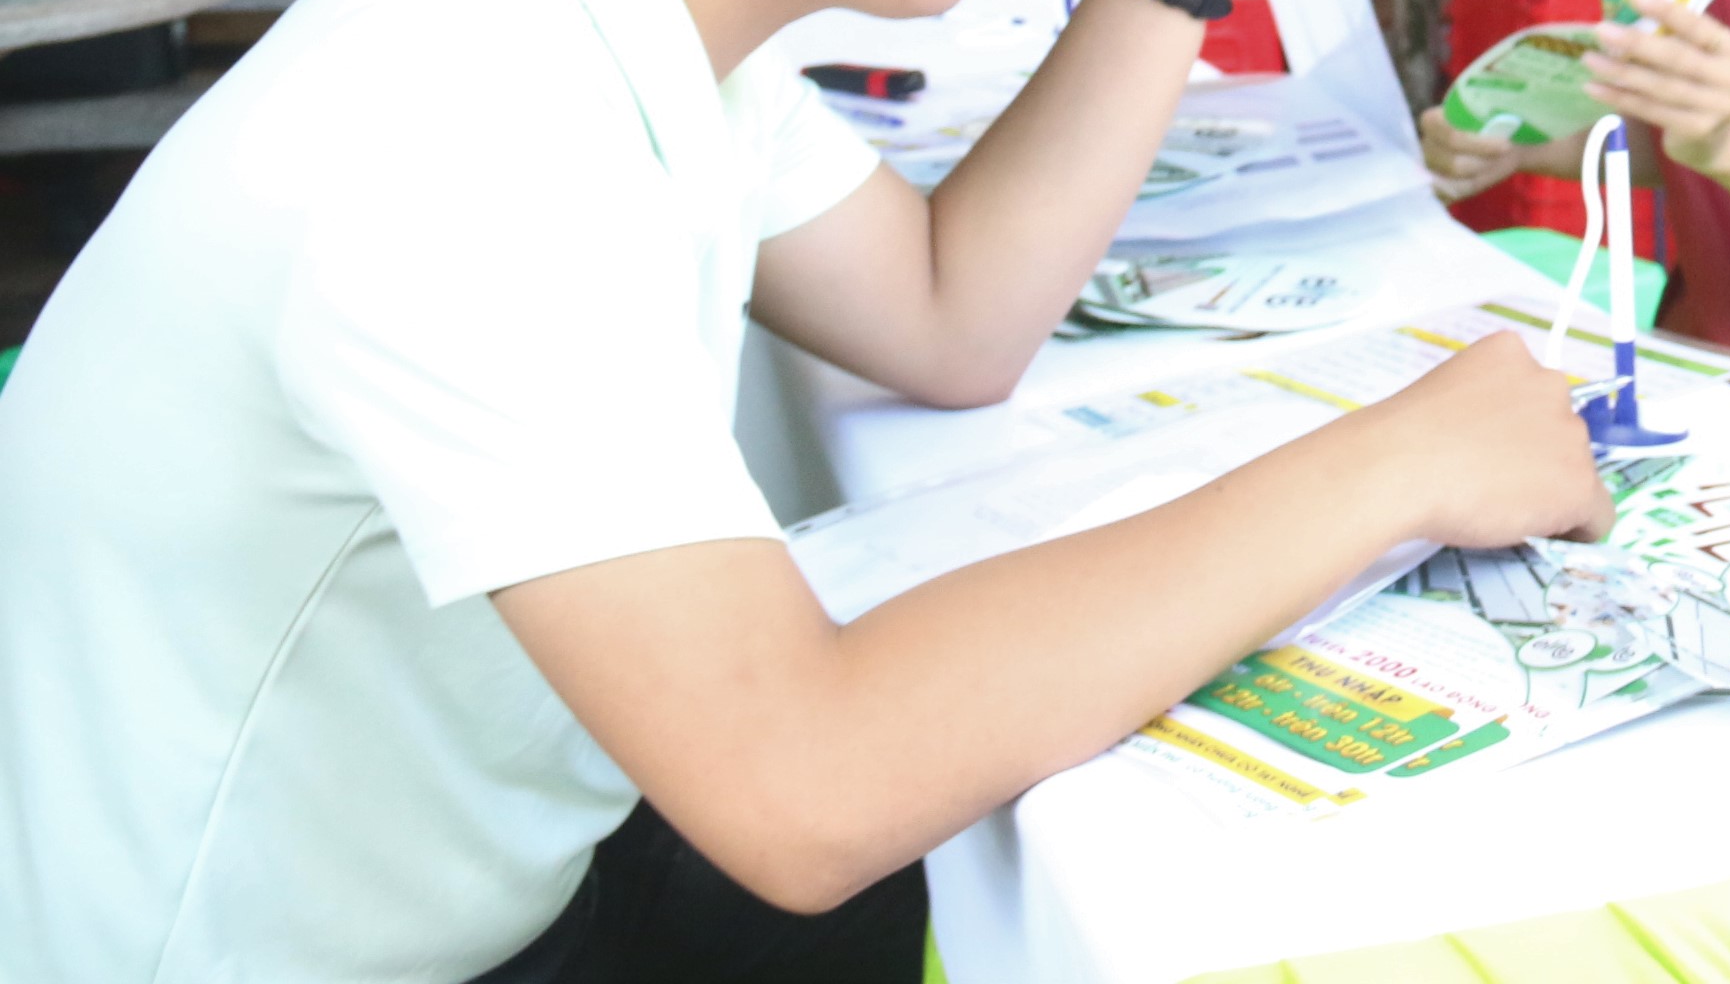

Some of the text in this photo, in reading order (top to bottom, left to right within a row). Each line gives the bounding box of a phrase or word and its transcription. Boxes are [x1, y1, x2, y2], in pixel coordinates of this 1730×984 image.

[1290, 654, 1336, 679] THU
[1349, 649, 1419, 680] 2000
[1272, 709, 1328, 743] trên
[1325, 735, 1386, 766] 30tr
[1303, 694, 1359, 724] trên
[1358, 716, 1417, 747] 12tr
